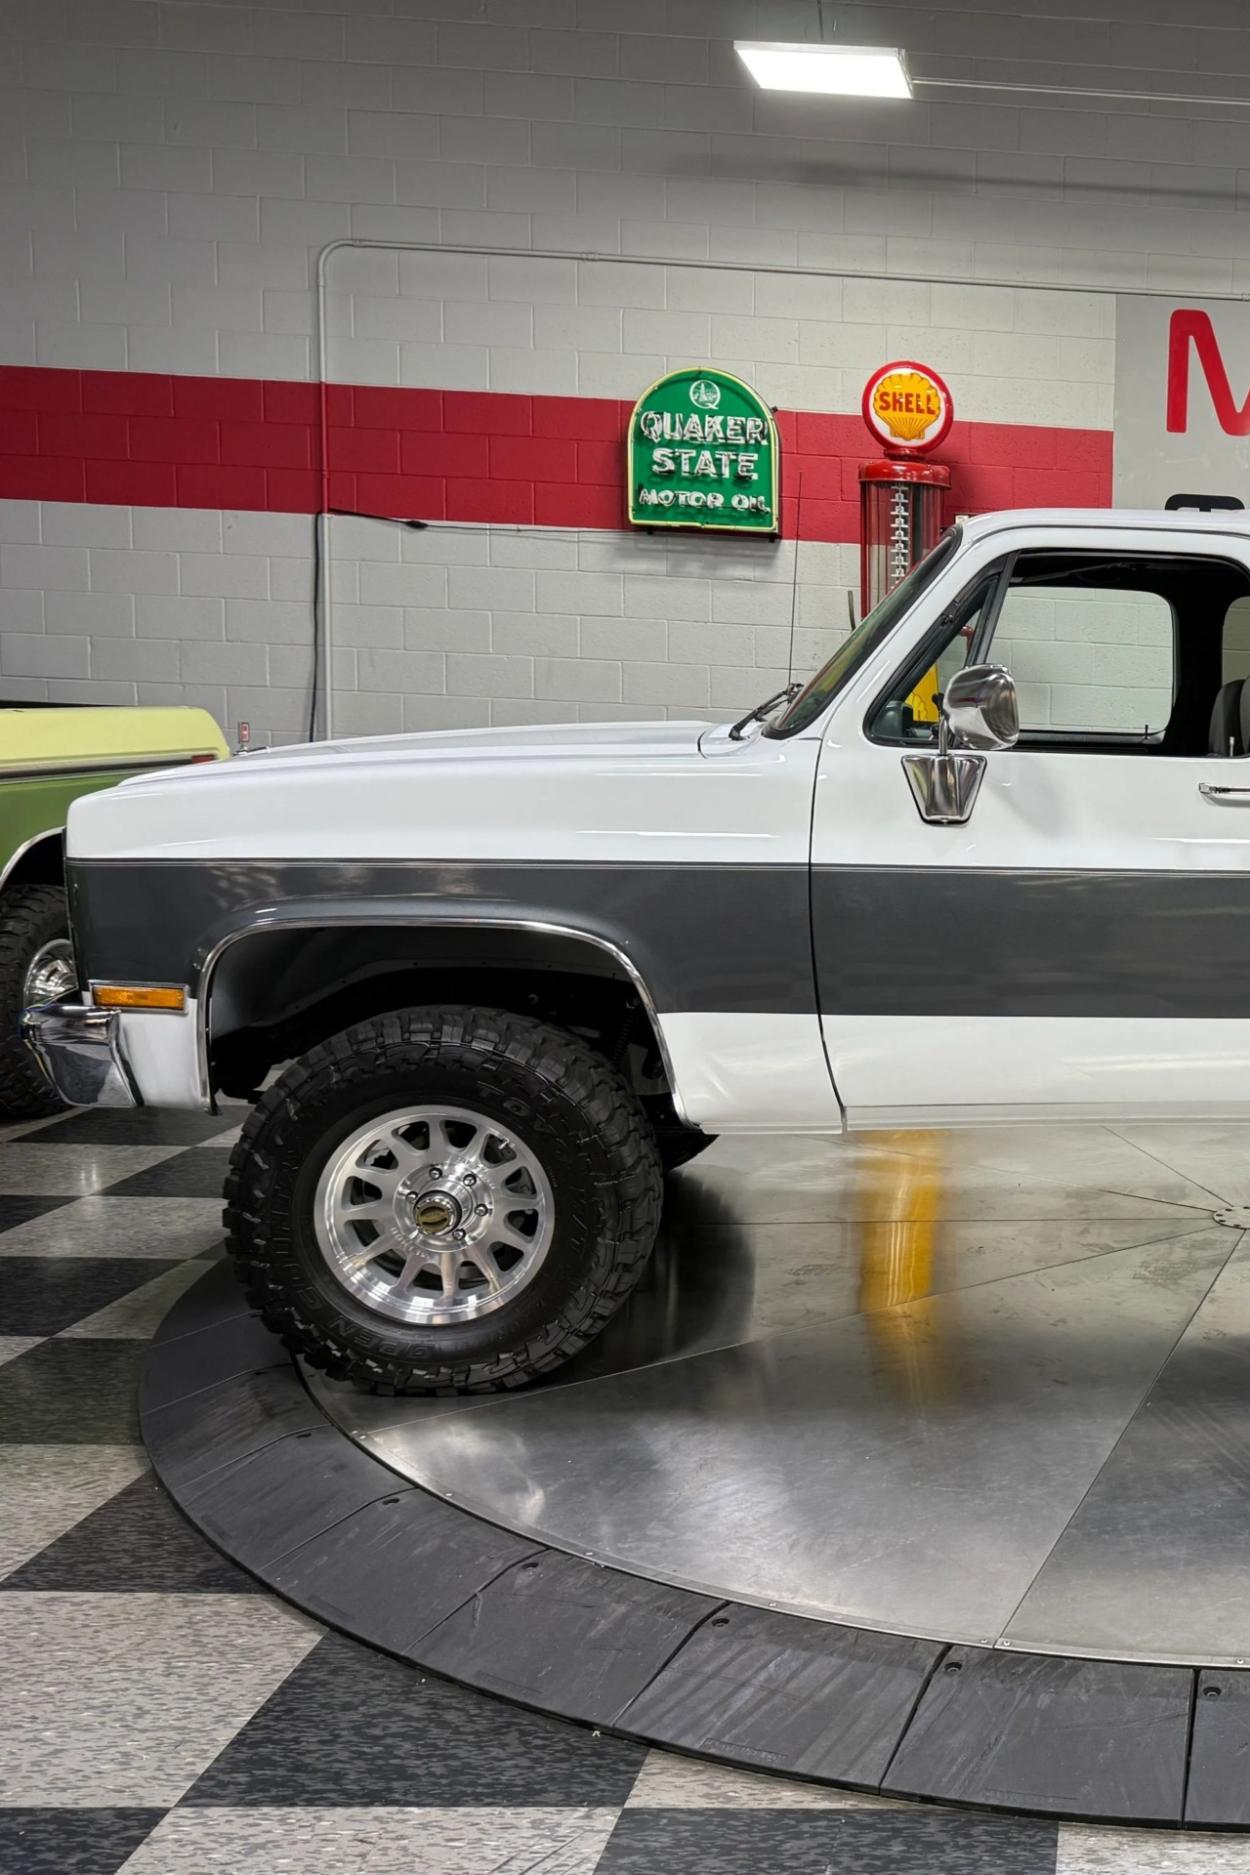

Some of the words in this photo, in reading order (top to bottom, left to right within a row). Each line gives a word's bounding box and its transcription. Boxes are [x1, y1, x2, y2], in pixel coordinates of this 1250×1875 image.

[878, 391, 936, 416] SHELL
[641, 411, 768, 445] QUAKER
[651, 448, 759, 480] STATE
[639, 487, 724, 509] MOTOR
[731, 494, 770, 512] OIL
